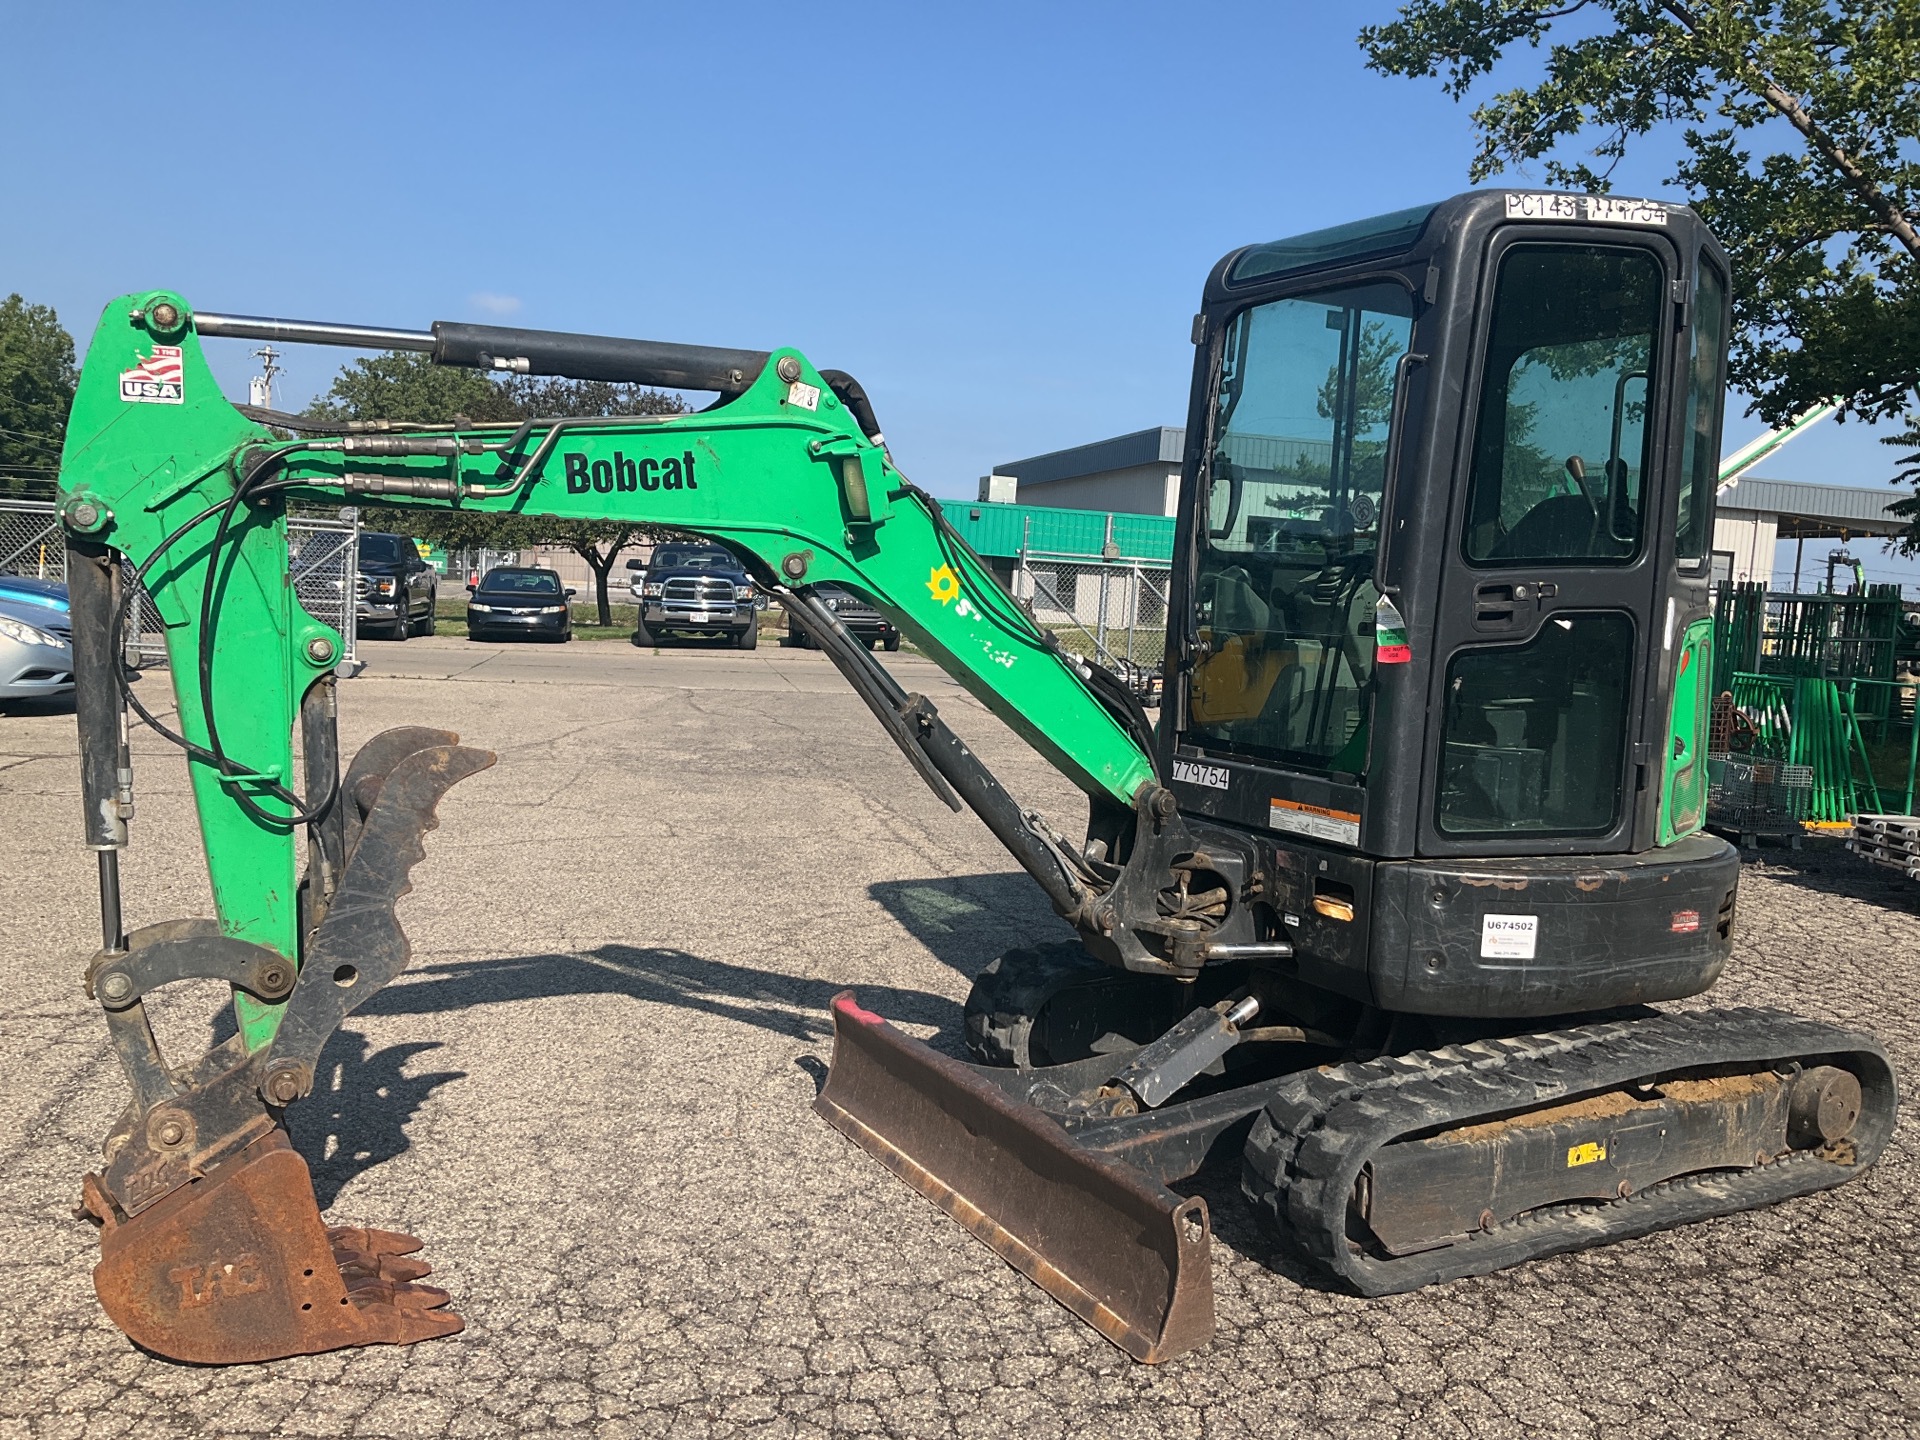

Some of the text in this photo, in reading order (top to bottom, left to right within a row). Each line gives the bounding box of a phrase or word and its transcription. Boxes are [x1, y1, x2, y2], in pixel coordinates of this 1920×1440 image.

[162, 349, 177, 357] THE
[124, 382, 179, 399] USA
[563, 450, 698, 495] Bobcat
[1174, 760, 1228, 788] 779754
[1304, 805, 1331, 817] WARNING
[1487, 921, 1533, 931] U674502
